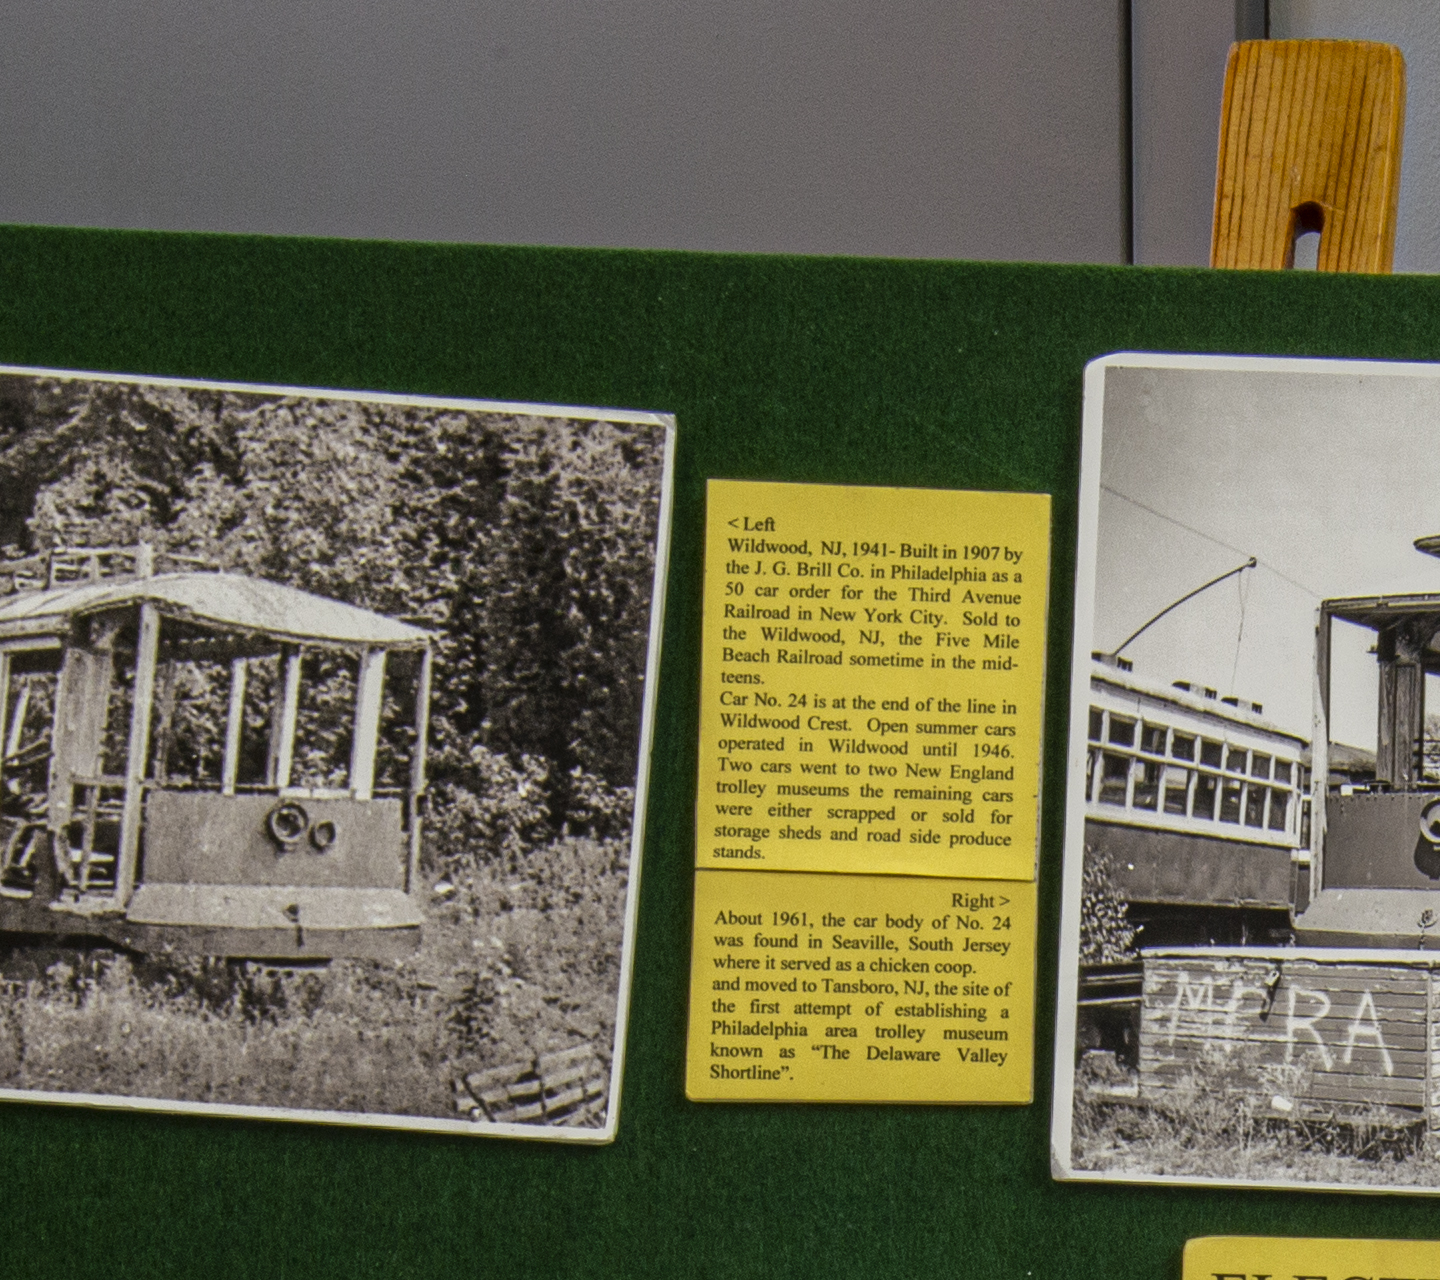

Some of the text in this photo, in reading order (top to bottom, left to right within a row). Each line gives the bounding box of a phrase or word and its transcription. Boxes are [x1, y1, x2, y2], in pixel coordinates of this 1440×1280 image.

[728, 538, 1023, 565] Wildwood, NJ, 1941- Built in 1907 by
[724, 604, 1021, 628] Railroad in New York City. Sold to
[723, 647, 1018, 671] Beach Railroad sometime in the mid-
[718, 737, 1014, 758] operated in Wildwood until 1946.
[714, 932, 1011, 957] was found in Seaville, South Jersey
[712, 998, 1009, 1022] the first attempt of establishing a
[711, 1020, 1008, 1043] Philadelphia area trolley museum
[710, 1042, 1008, 1067] known as “The Delaware Valley
[710, 1064, 793, 1080] Shortline”.
